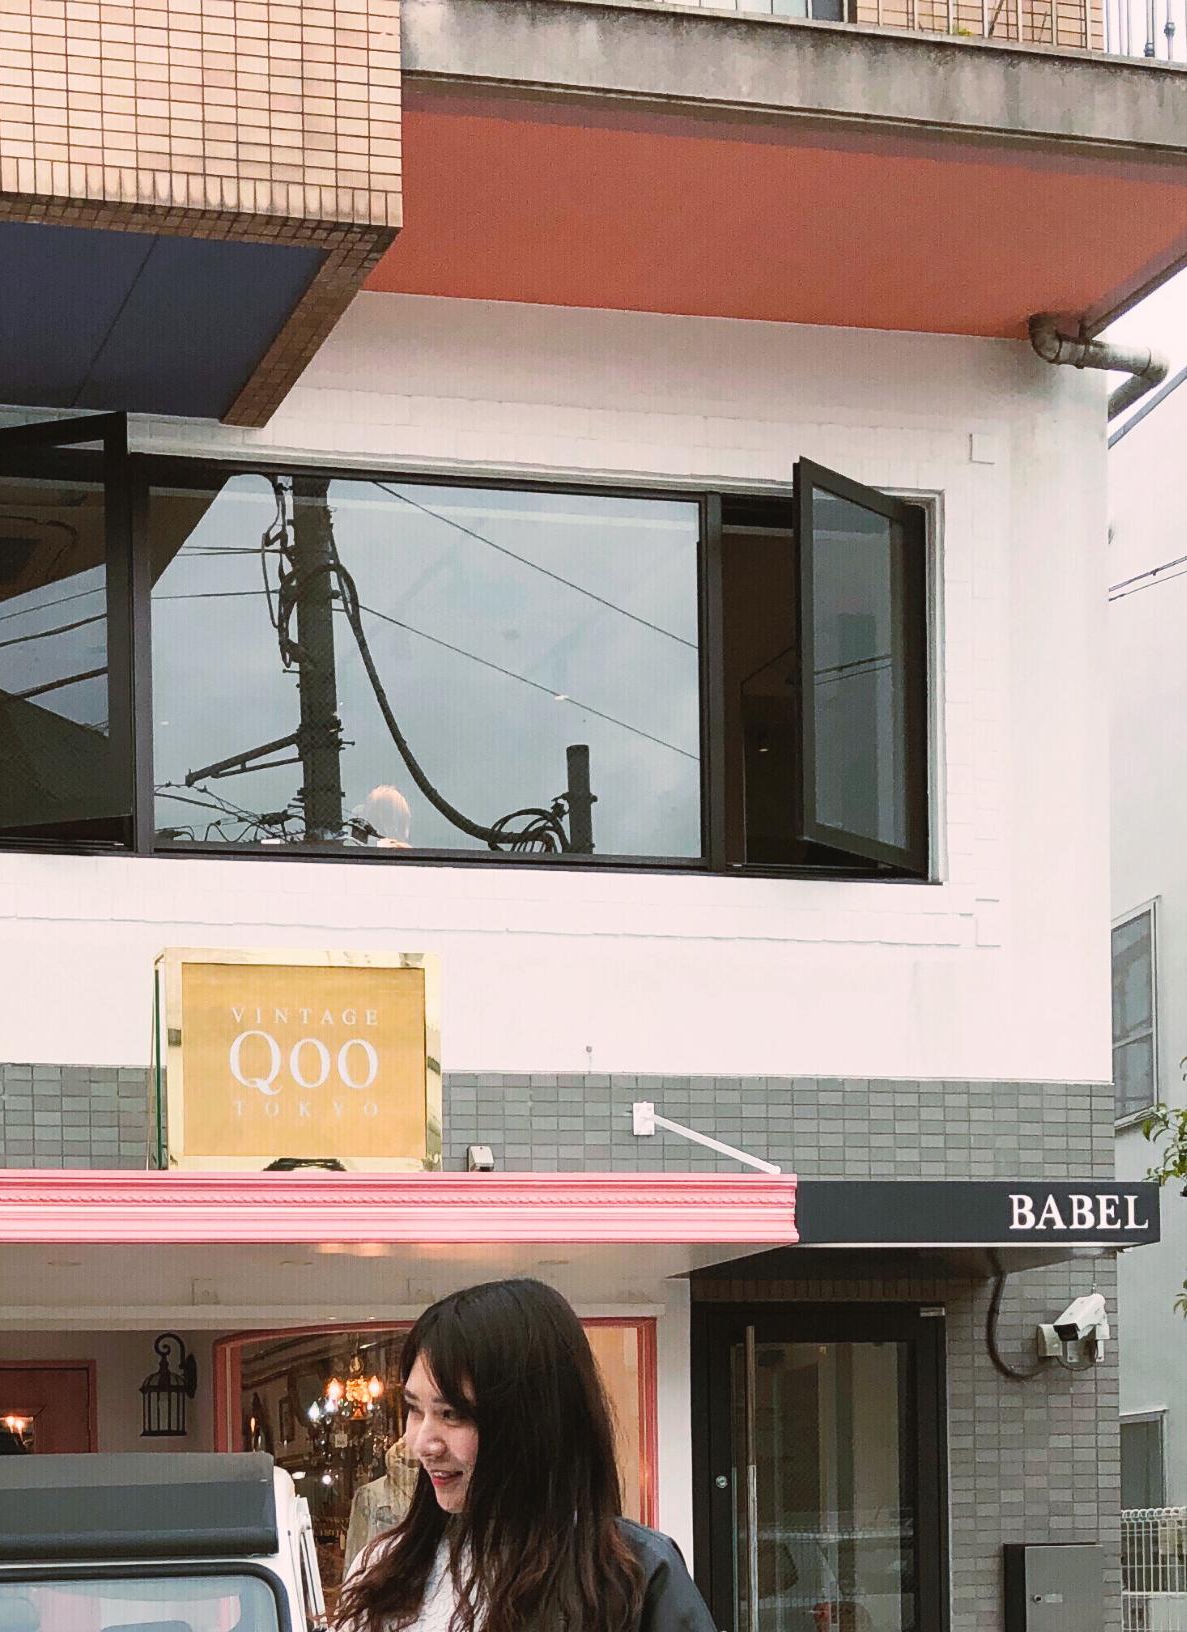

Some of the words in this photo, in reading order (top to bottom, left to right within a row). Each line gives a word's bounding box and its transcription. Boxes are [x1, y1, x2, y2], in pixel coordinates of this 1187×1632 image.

[232, 1007, 378, 1025] VINTAGE
[229, 1030, 378, 1095] QOO
[235, 1100, 378, 1117] TOKYO
[1008, 1193, 1149, 1230] BABEL
